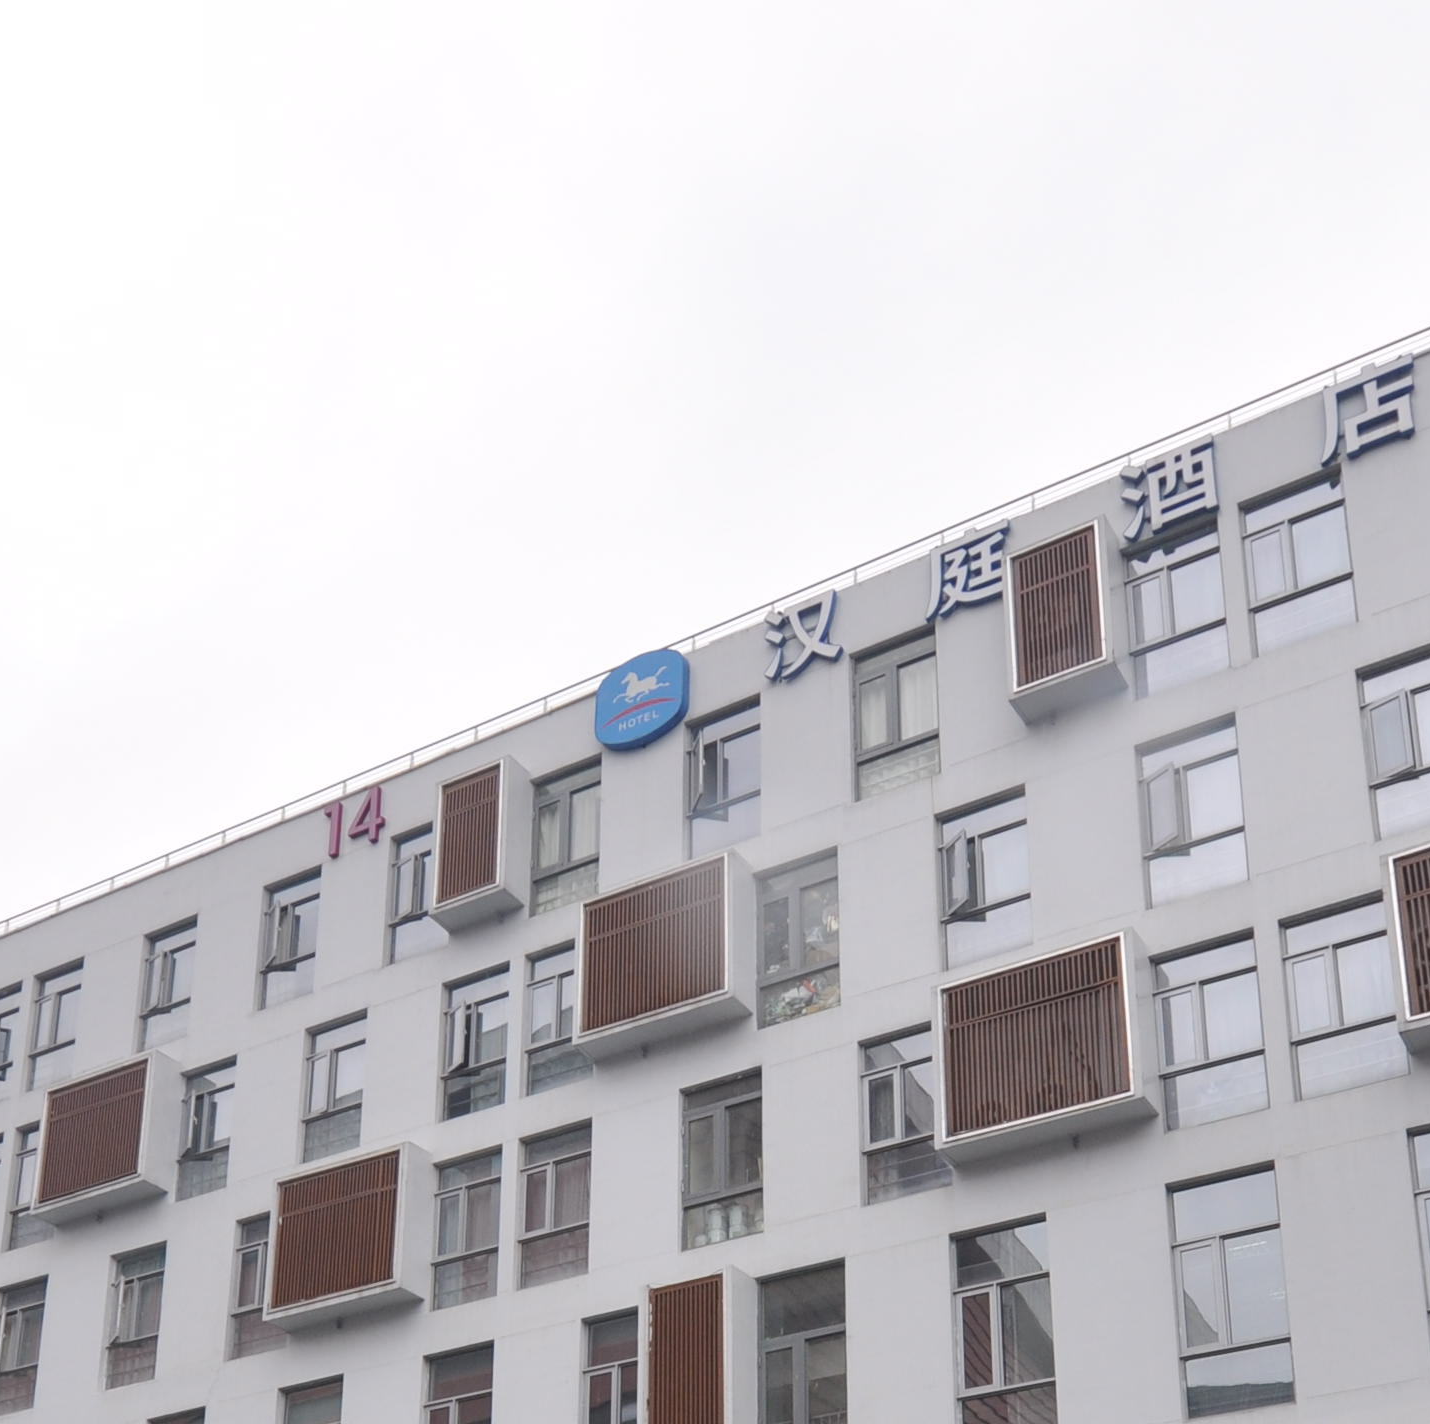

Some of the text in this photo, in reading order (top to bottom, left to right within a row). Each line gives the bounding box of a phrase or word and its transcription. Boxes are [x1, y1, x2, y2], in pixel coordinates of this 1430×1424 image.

[764, 353, 1415, 684] 汉庭酒店
[618, 710, 660, 732] HOTEL
[324, 785, 387, 859] 14
